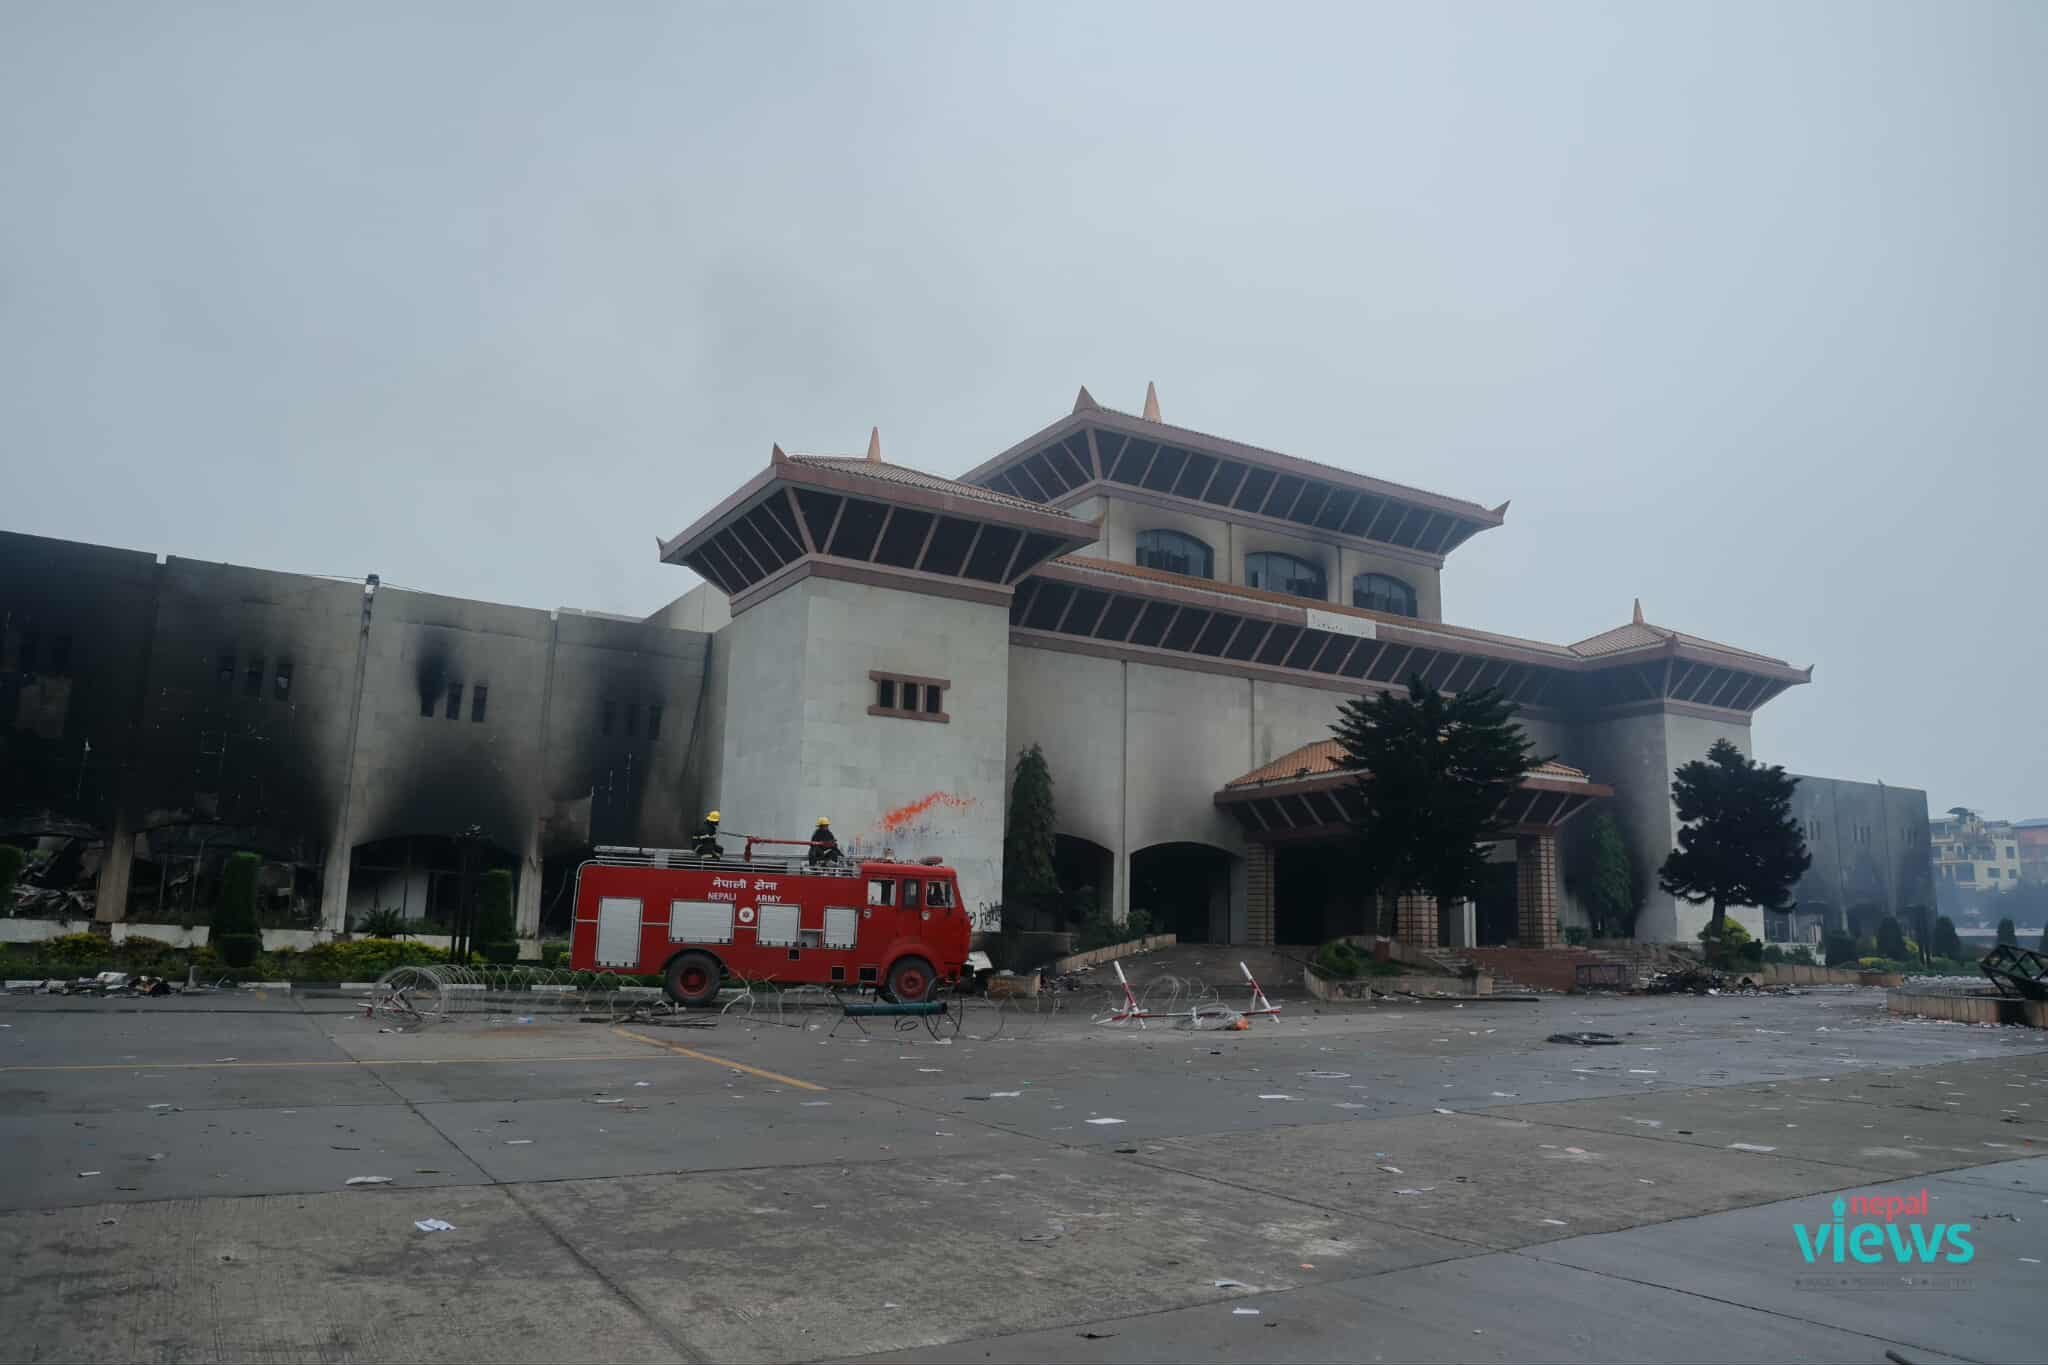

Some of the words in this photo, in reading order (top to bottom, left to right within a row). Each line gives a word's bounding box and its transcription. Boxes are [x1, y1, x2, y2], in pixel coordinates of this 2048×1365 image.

[712, 877, 747, 889] नेपाली
[754, 879, 778, 891] सेना
[707, 892, 737, 901] NEPALI
[755, 894, 782, 903] ARMY
